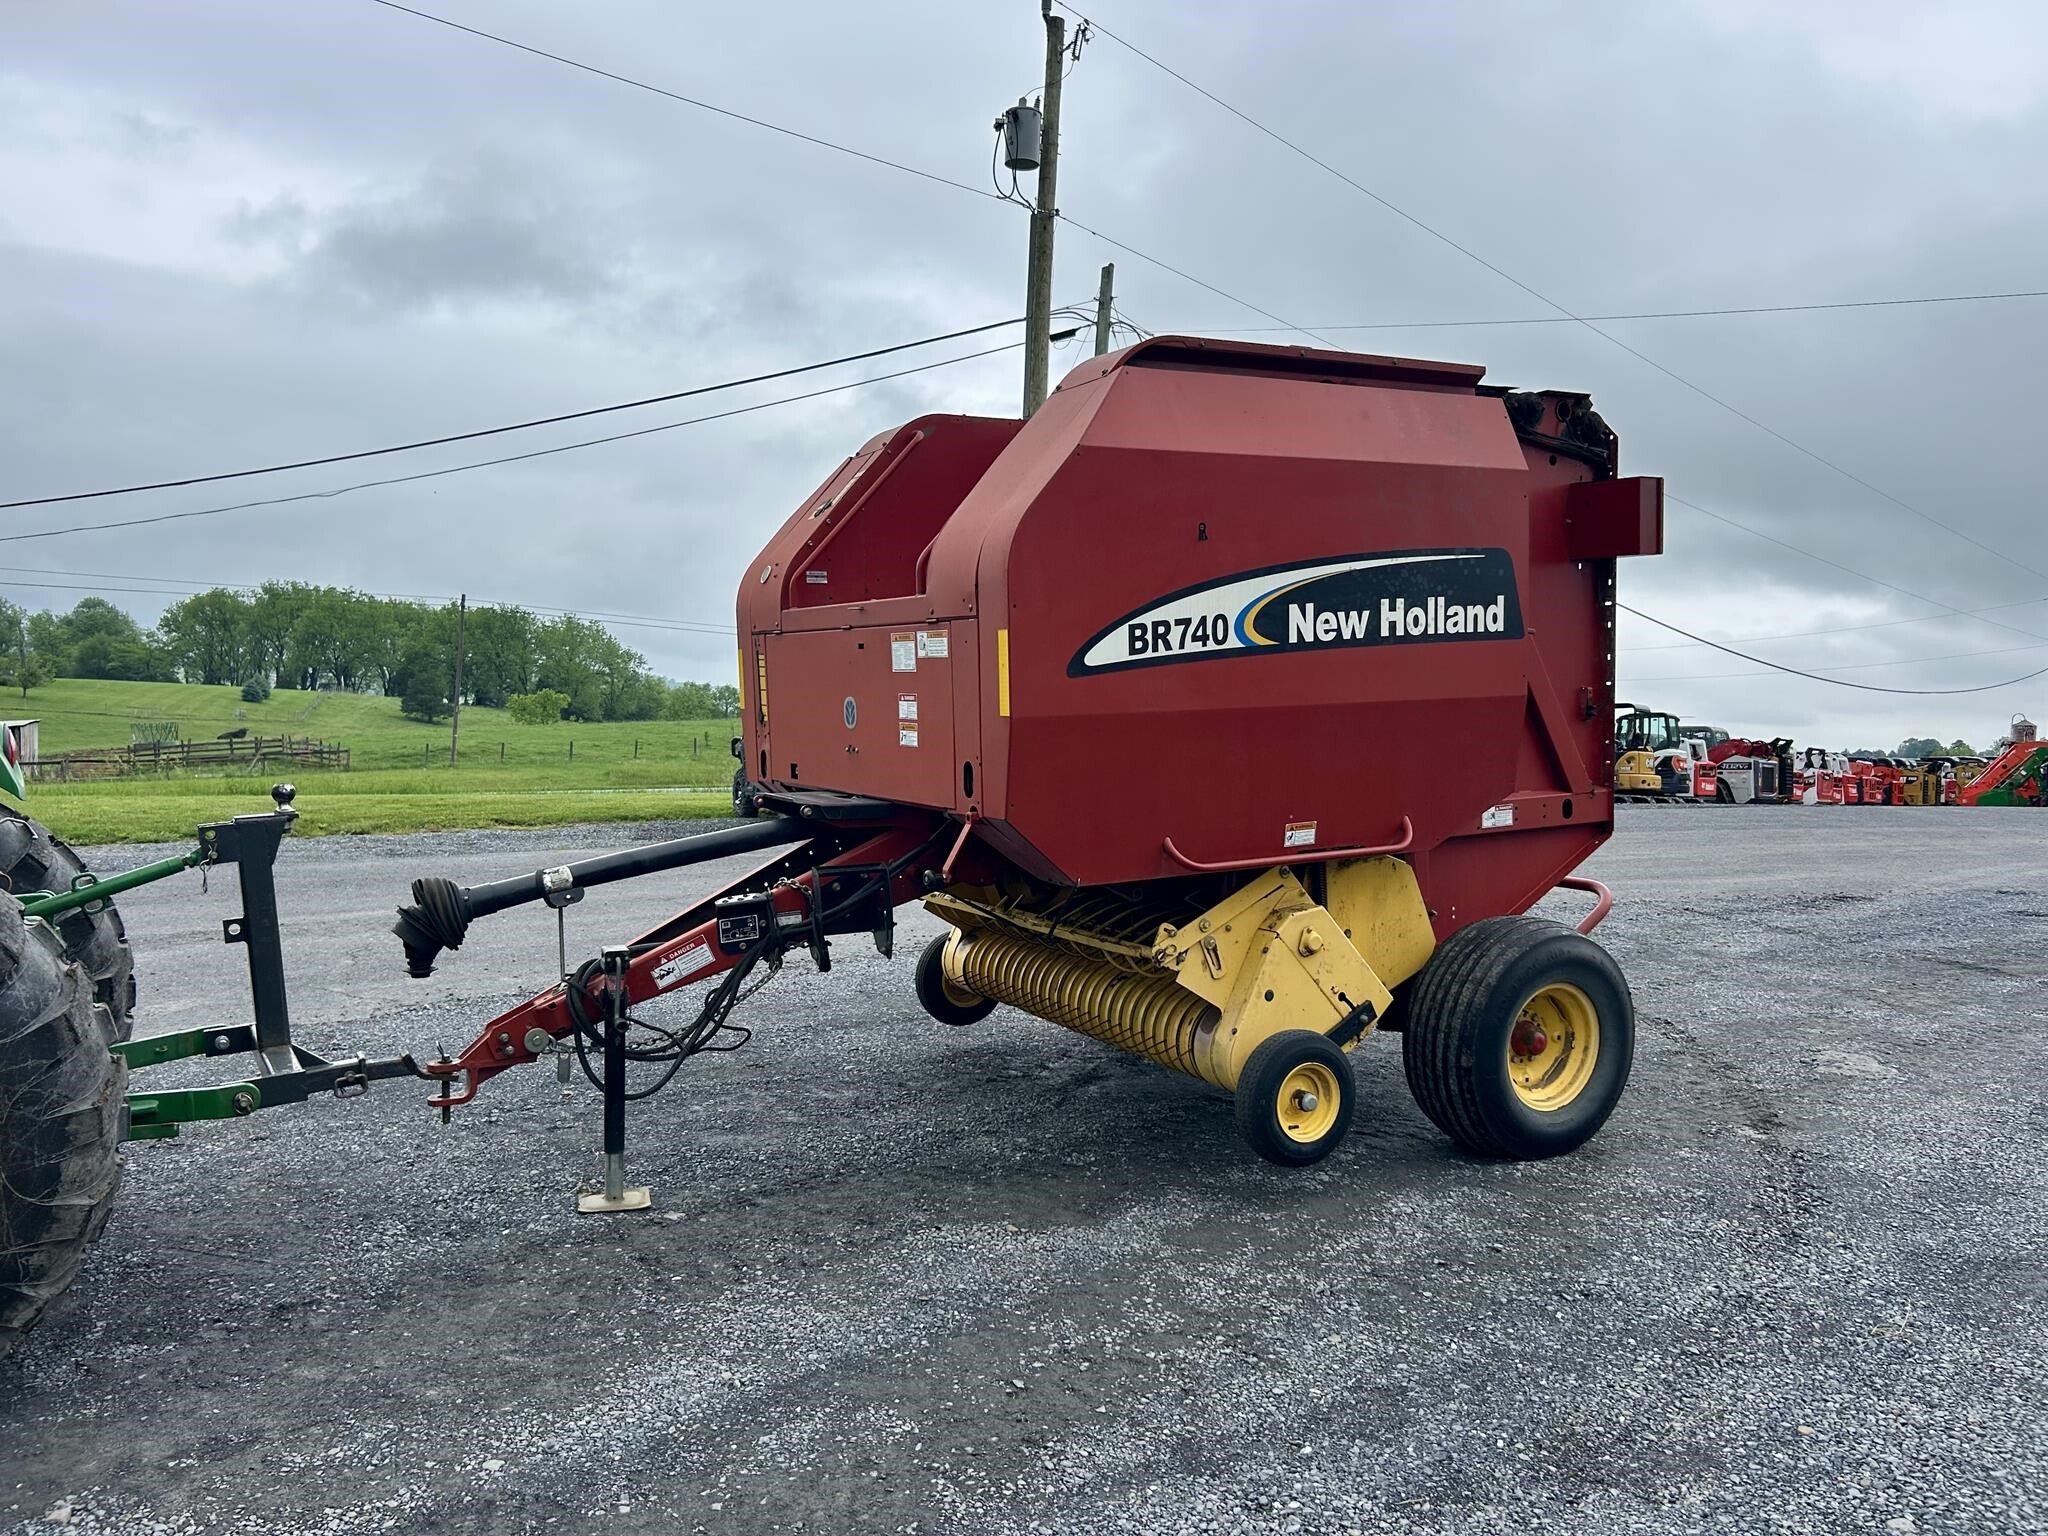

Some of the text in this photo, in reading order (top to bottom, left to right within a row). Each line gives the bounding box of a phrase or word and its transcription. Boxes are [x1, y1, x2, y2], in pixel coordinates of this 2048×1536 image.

[1128, 613, 1229, 656] BR740
[1288, 595, 1505, 644] New Holland
[669, 942, 695, 959] DANGER
